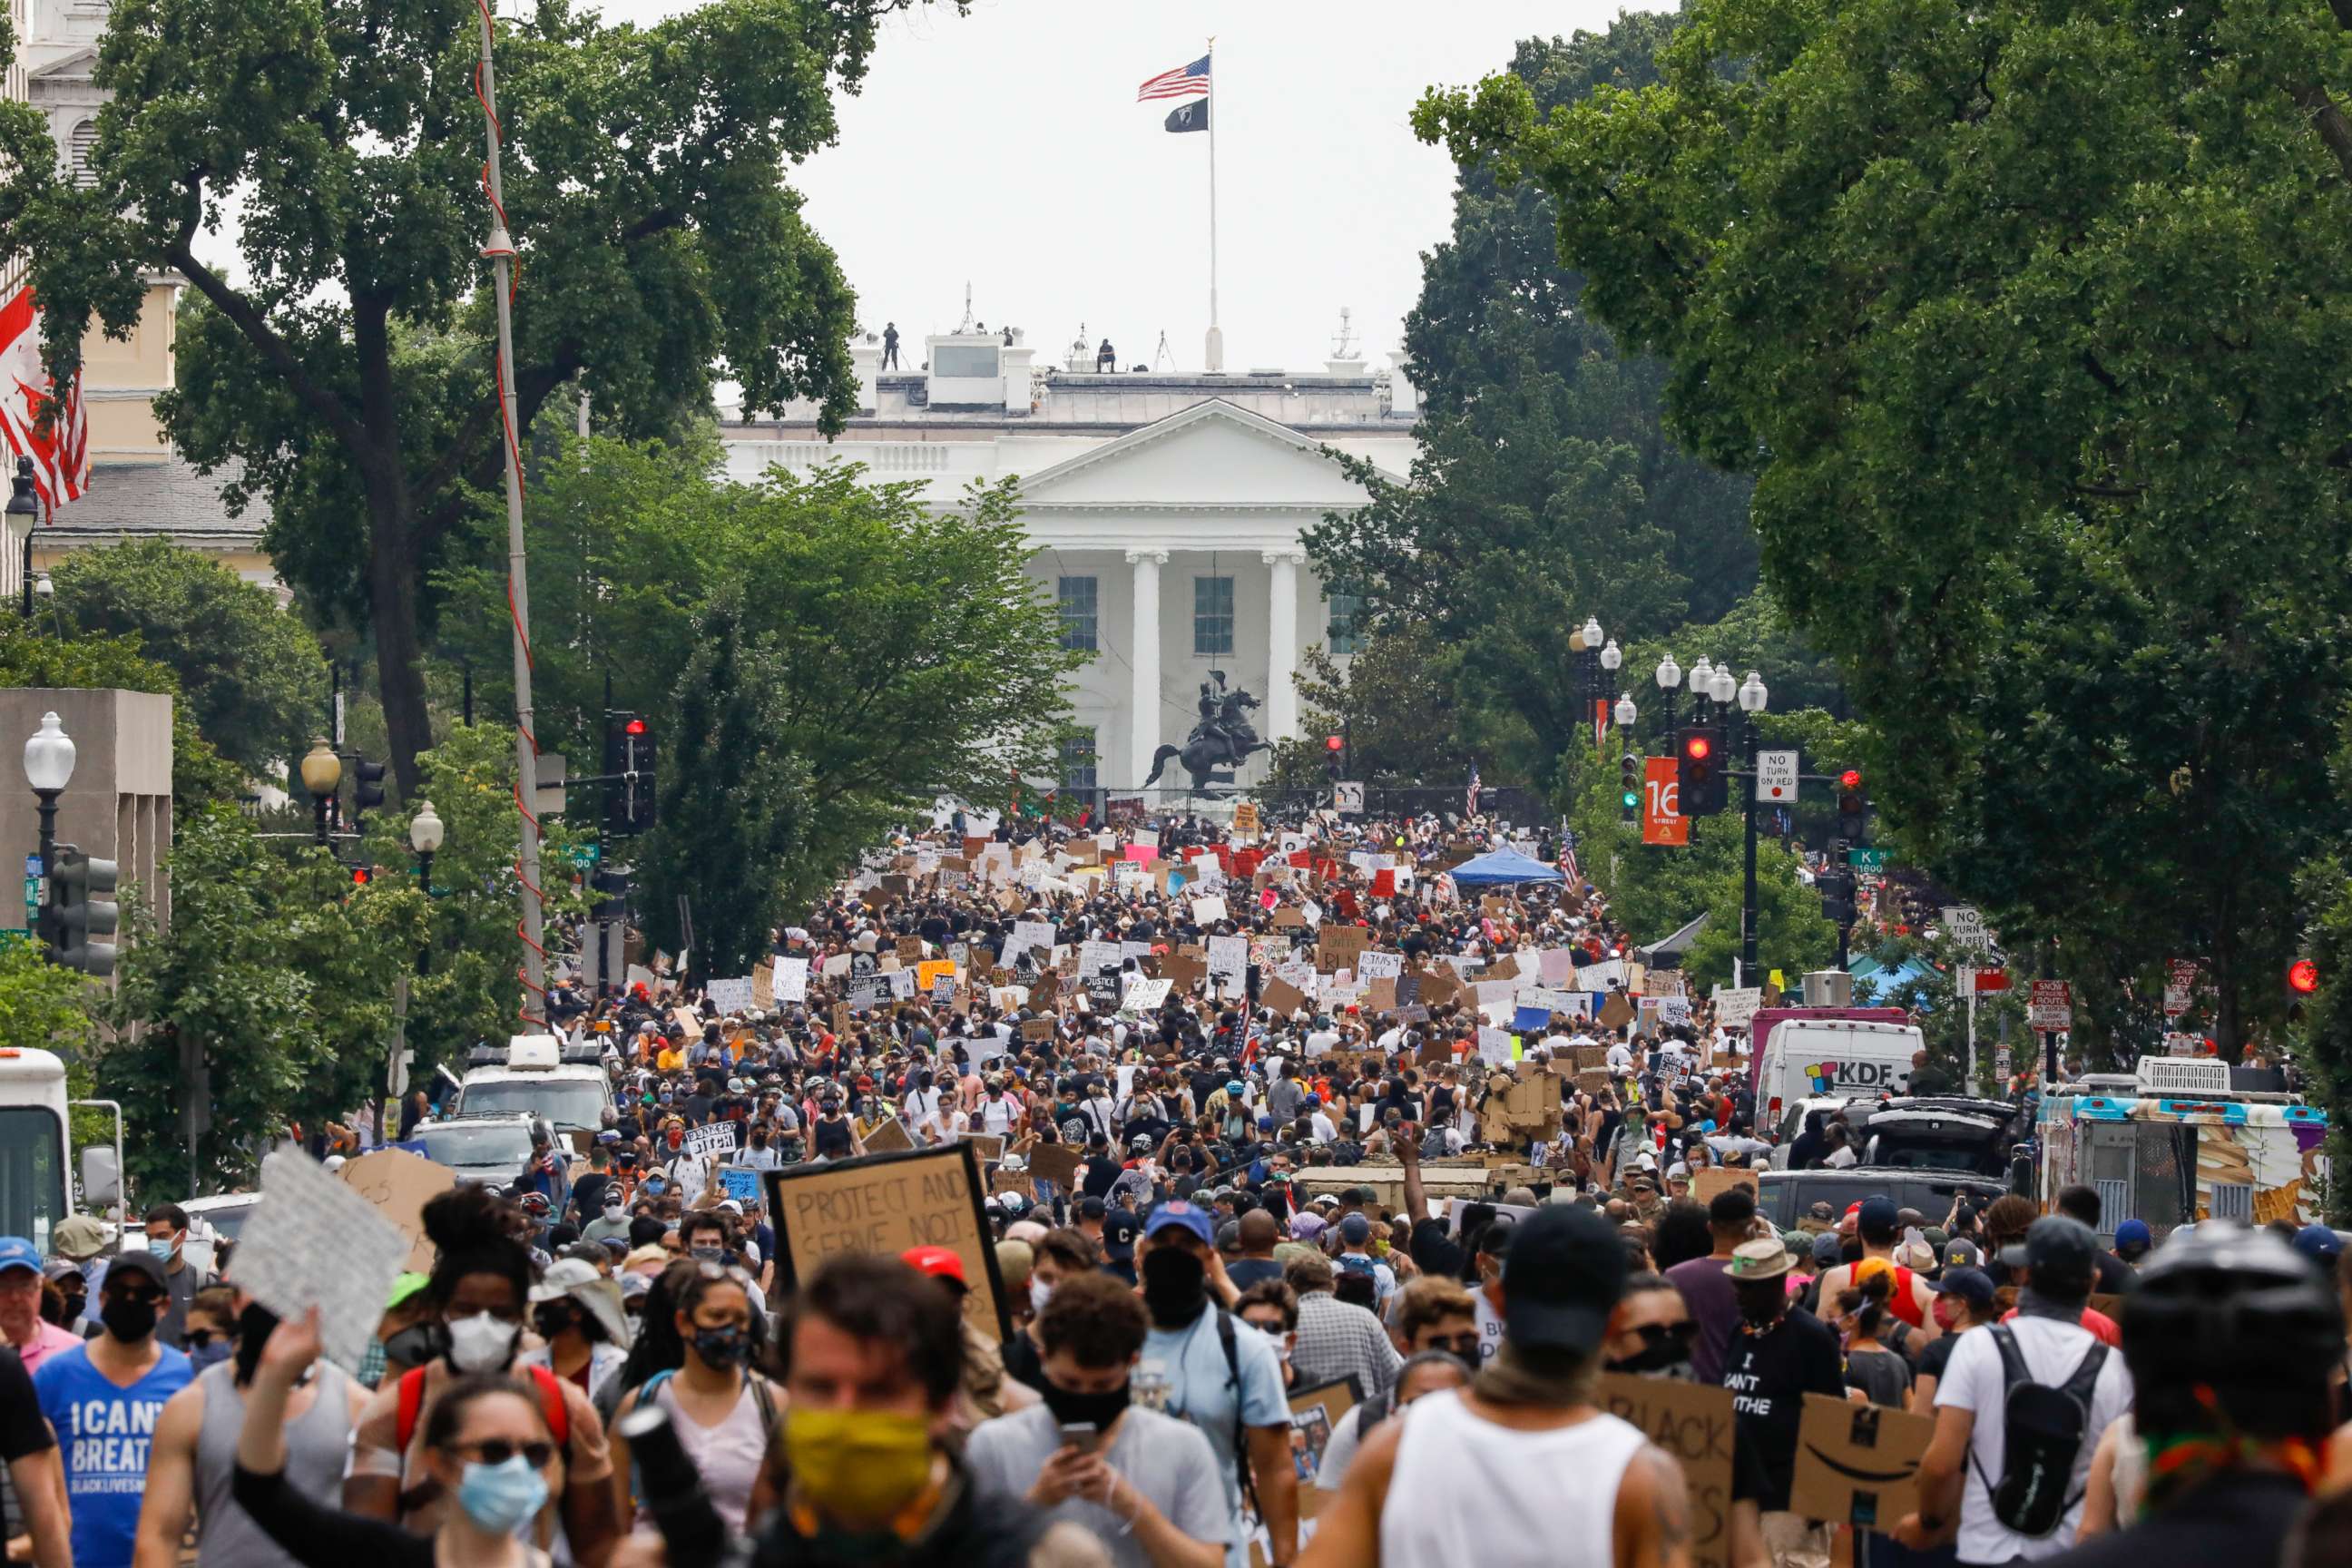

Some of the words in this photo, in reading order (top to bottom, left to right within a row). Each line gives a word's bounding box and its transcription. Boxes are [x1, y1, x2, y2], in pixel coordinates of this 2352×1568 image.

[1769, 755, 1786, 765] NO
[1766, 766, 1788, 776] TURN
[1760, 777, 1774, 786] ON
[1776, 777, 1794, 786] RED
[1646, 780, 1680, 817] 16
[1861, 851, 1873, 863] K
[1956, 912, 1976, 923] NO
[1954, 925, 1980, 936] TURN
[1965, 936, 1985, 946] RED
[1359, 965, 1387, 977] BLACK
[1087, 977, 1115, 987] JUSTICE
[1133, 980, 1164, 993] END
[2038, 982, 2063, 991] SNOW
[2035, 997, 2065, 1005] ROUTE
[1662, 1054, 1684, 1068] BLACK
[1838, 1061, 1893, 1086] KDF
[799, 1178, 907, 1231] PROTECT
[921, 1171, 967, 1217] AND
[1119, 1229, 1129, 1243] C
[1951, 1254, 1966, 1264] M
[1742, 1353, 1753, 1369] I
[71, 1404, 82, 1436] I
[85, 1399, 163, 1435] CAN'
[72, 1436, 152, 1473] BREAT
